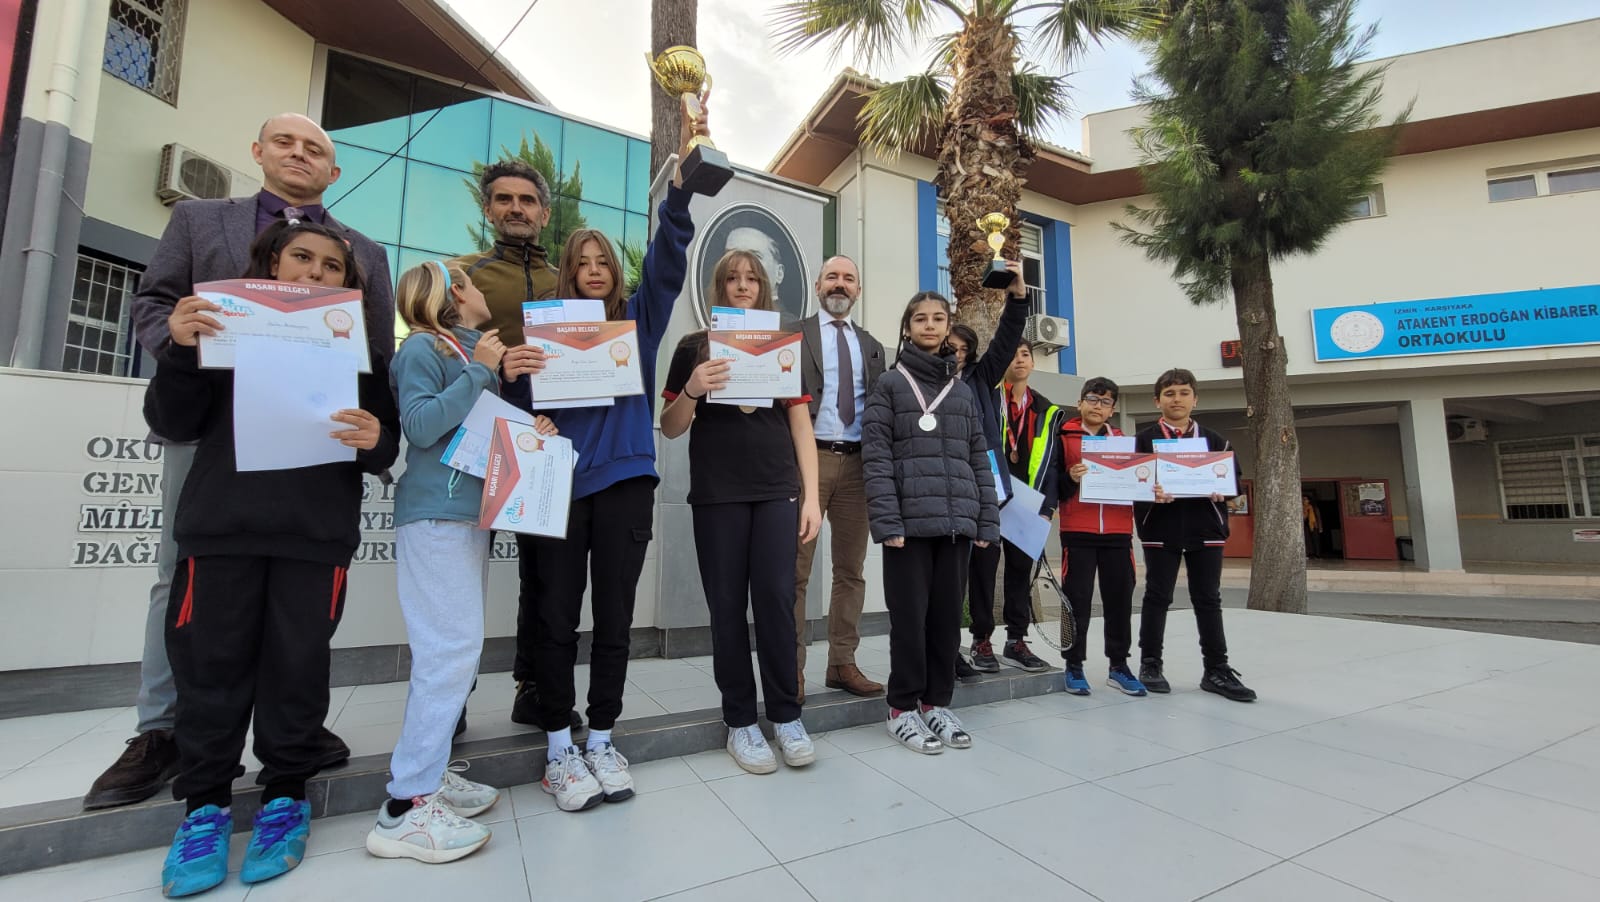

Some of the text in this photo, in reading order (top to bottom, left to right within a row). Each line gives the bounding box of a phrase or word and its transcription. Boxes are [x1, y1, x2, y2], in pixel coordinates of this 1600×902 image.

[1397, 304, 1599, 331] ATAKENT ERDOĞAN KİBARER
[1398, 328, 1506, 348] ORTAOKULU
[83, 471, 163, 494] GEN
